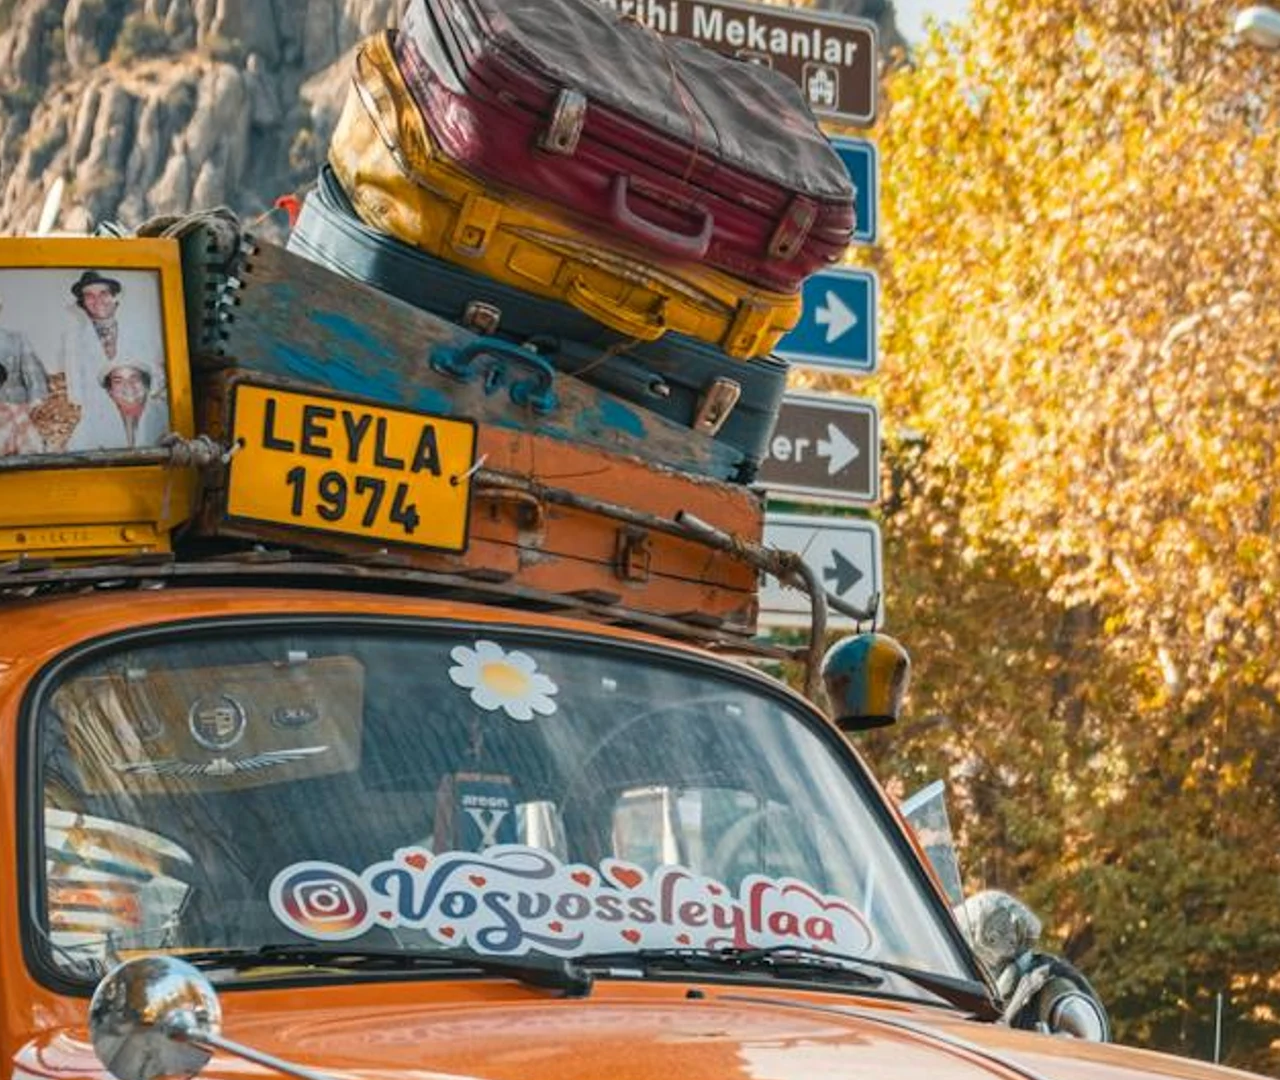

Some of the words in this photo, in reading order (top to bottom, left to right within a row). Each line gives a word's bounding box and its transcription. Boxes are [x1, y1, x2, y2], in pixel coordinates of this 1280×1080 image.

[599, 0, 679, 34] rihi
[693, 6, 858, 66] Mekanlar
[263, 399, 441, 477] LEYLA
[286, 466, 420, 534] 1974
